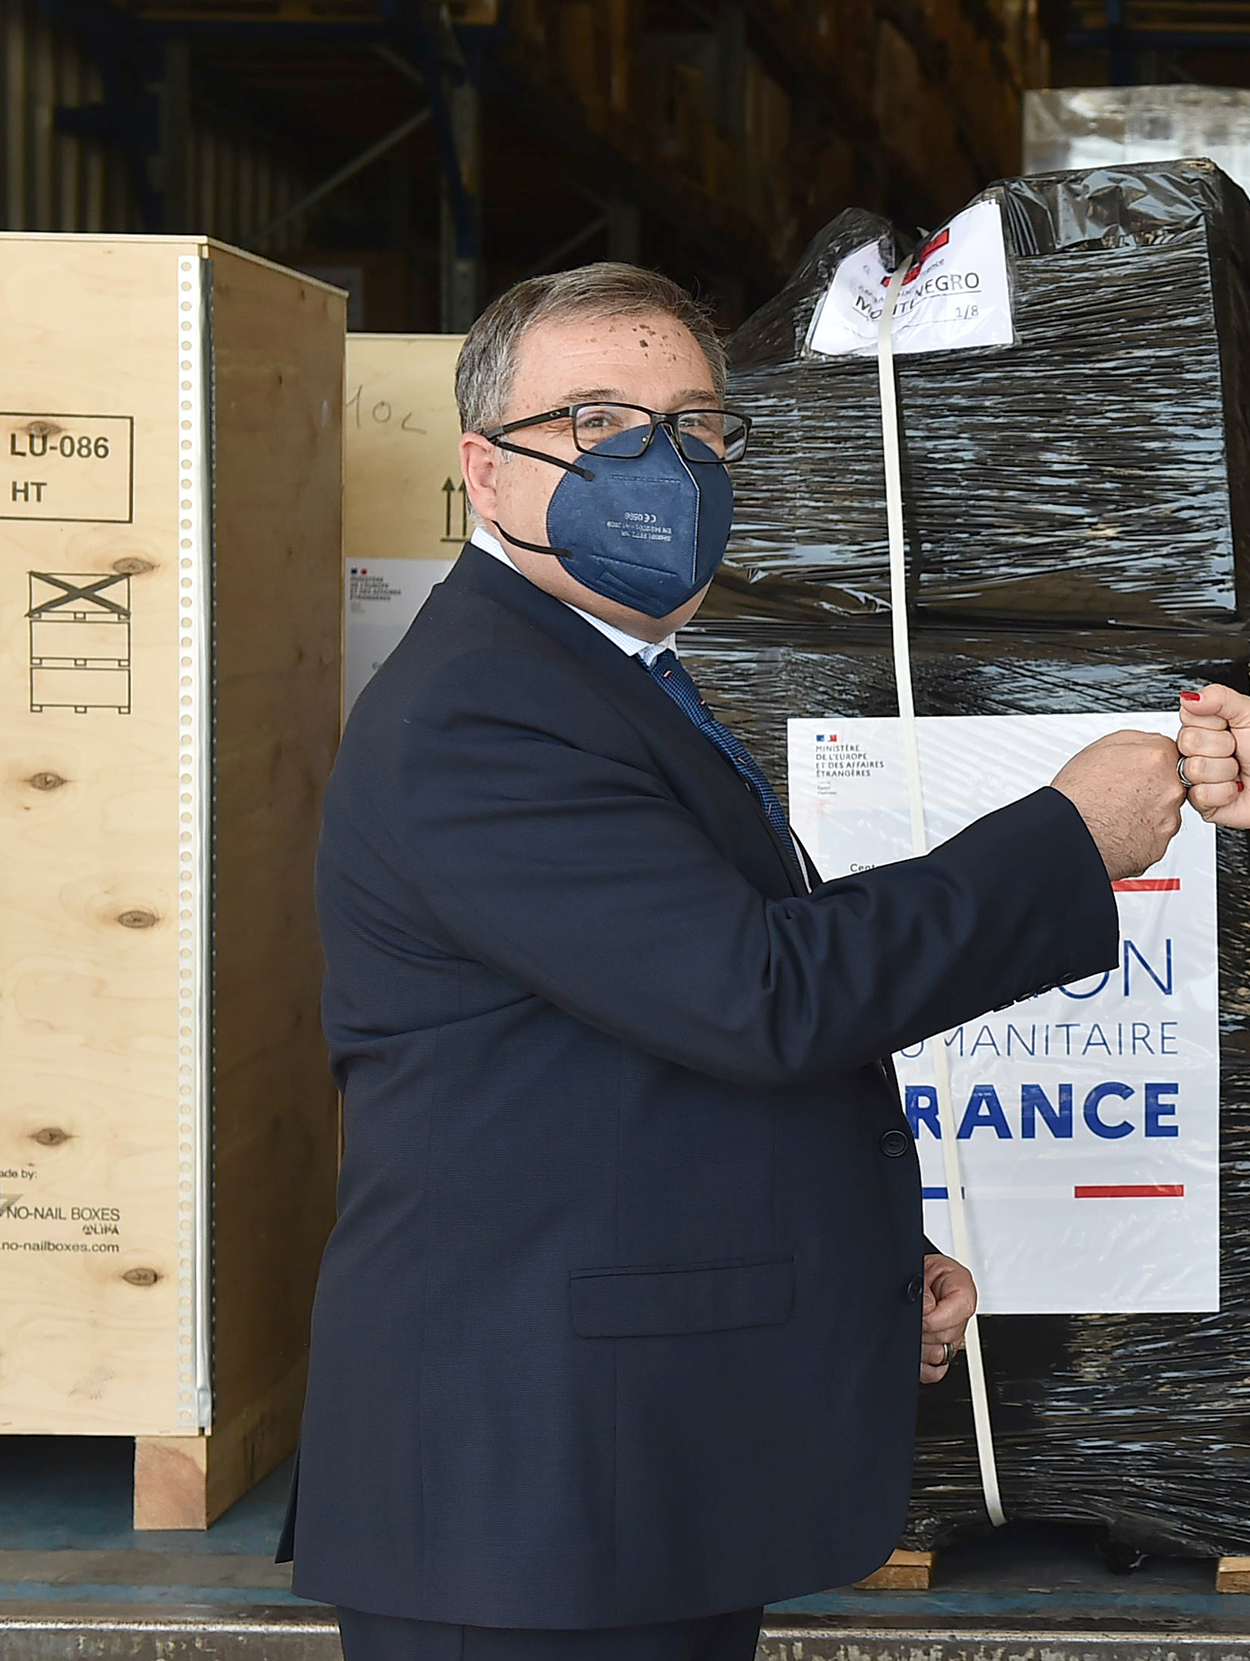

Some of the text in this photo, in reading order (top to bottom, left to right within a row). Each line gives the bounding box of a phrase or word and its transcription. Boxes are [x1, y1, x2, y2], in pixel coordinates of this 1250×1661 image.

[955, 304, 979, 320] 1/8
[10, 433, 110, 459] LU-086
[11, 481, 48, 502] HT
[815, 744, 860, 752] MINISTÈRE
[815, 753, 868, 761] DE L'EUROPE
[846, 761, 885, 769] AFFAIRES
[901, 1022, 1179, 1058] MANITAIRE
[905, 1082, 1179, 1140] RANCE
[0, 1169, 38, 1181] ade by:
[6, 1206, 120, 1221] NO-NAIL BOXES
